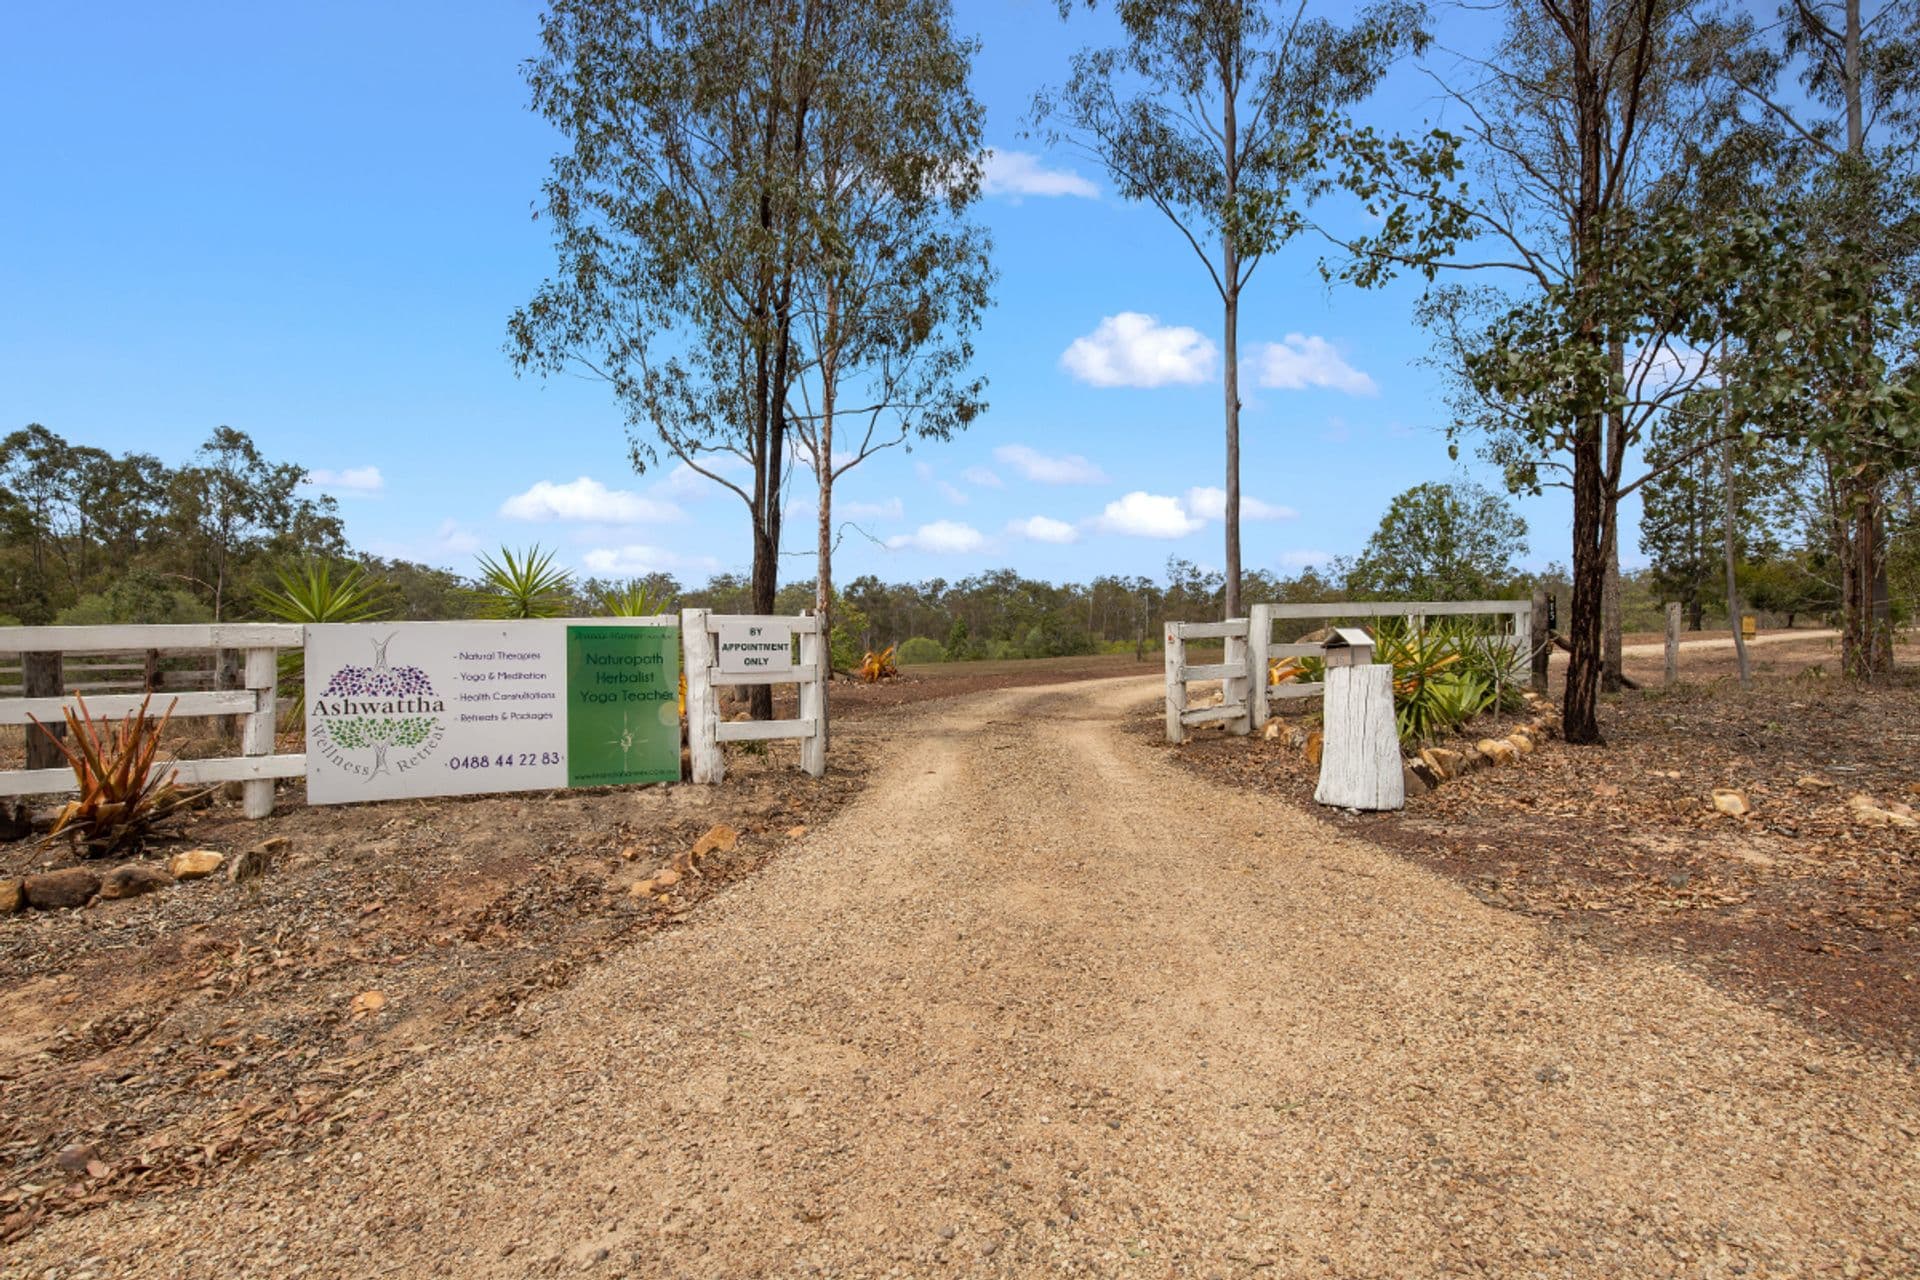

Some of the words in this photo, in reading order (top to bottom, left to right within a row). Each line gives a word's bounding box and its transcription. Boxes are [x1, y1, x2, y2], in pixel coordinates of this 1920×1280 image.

[750, 627, 762, 636] BY
[722, 643, 789, 651] APPOINTMENT
[459, 652, 495, 661] Natural
[497, 651, 541, 662] Therapies
[586, 653, 664, 667] Naturopath
[744, 657, 769, 665] ONLY
[460, 672, 486, 682] Yoga
[488, 672, 495, 680] &
[497, 672, 547, 680] Meditation
[596, 671, 654, 684] Herbalist
[460, 692, 491, 702] Health
[580, 690, 618, 704] Yoga
[622, 689, 674, 702] Teacher
[312, 697, 446, 716] Ashwattha
[460, 713, 499, 722] Retreats
[510, 711, 553, 722] Packages
[311, 724, 370, 776] Wellness
[396, 725, 446, 772] Retreat
[449, 754, 490, 770] 0488
[495, 753, 514, 767] 44
[519, 752, 536, 766] 22
[541, 751, 560, 765] 83
